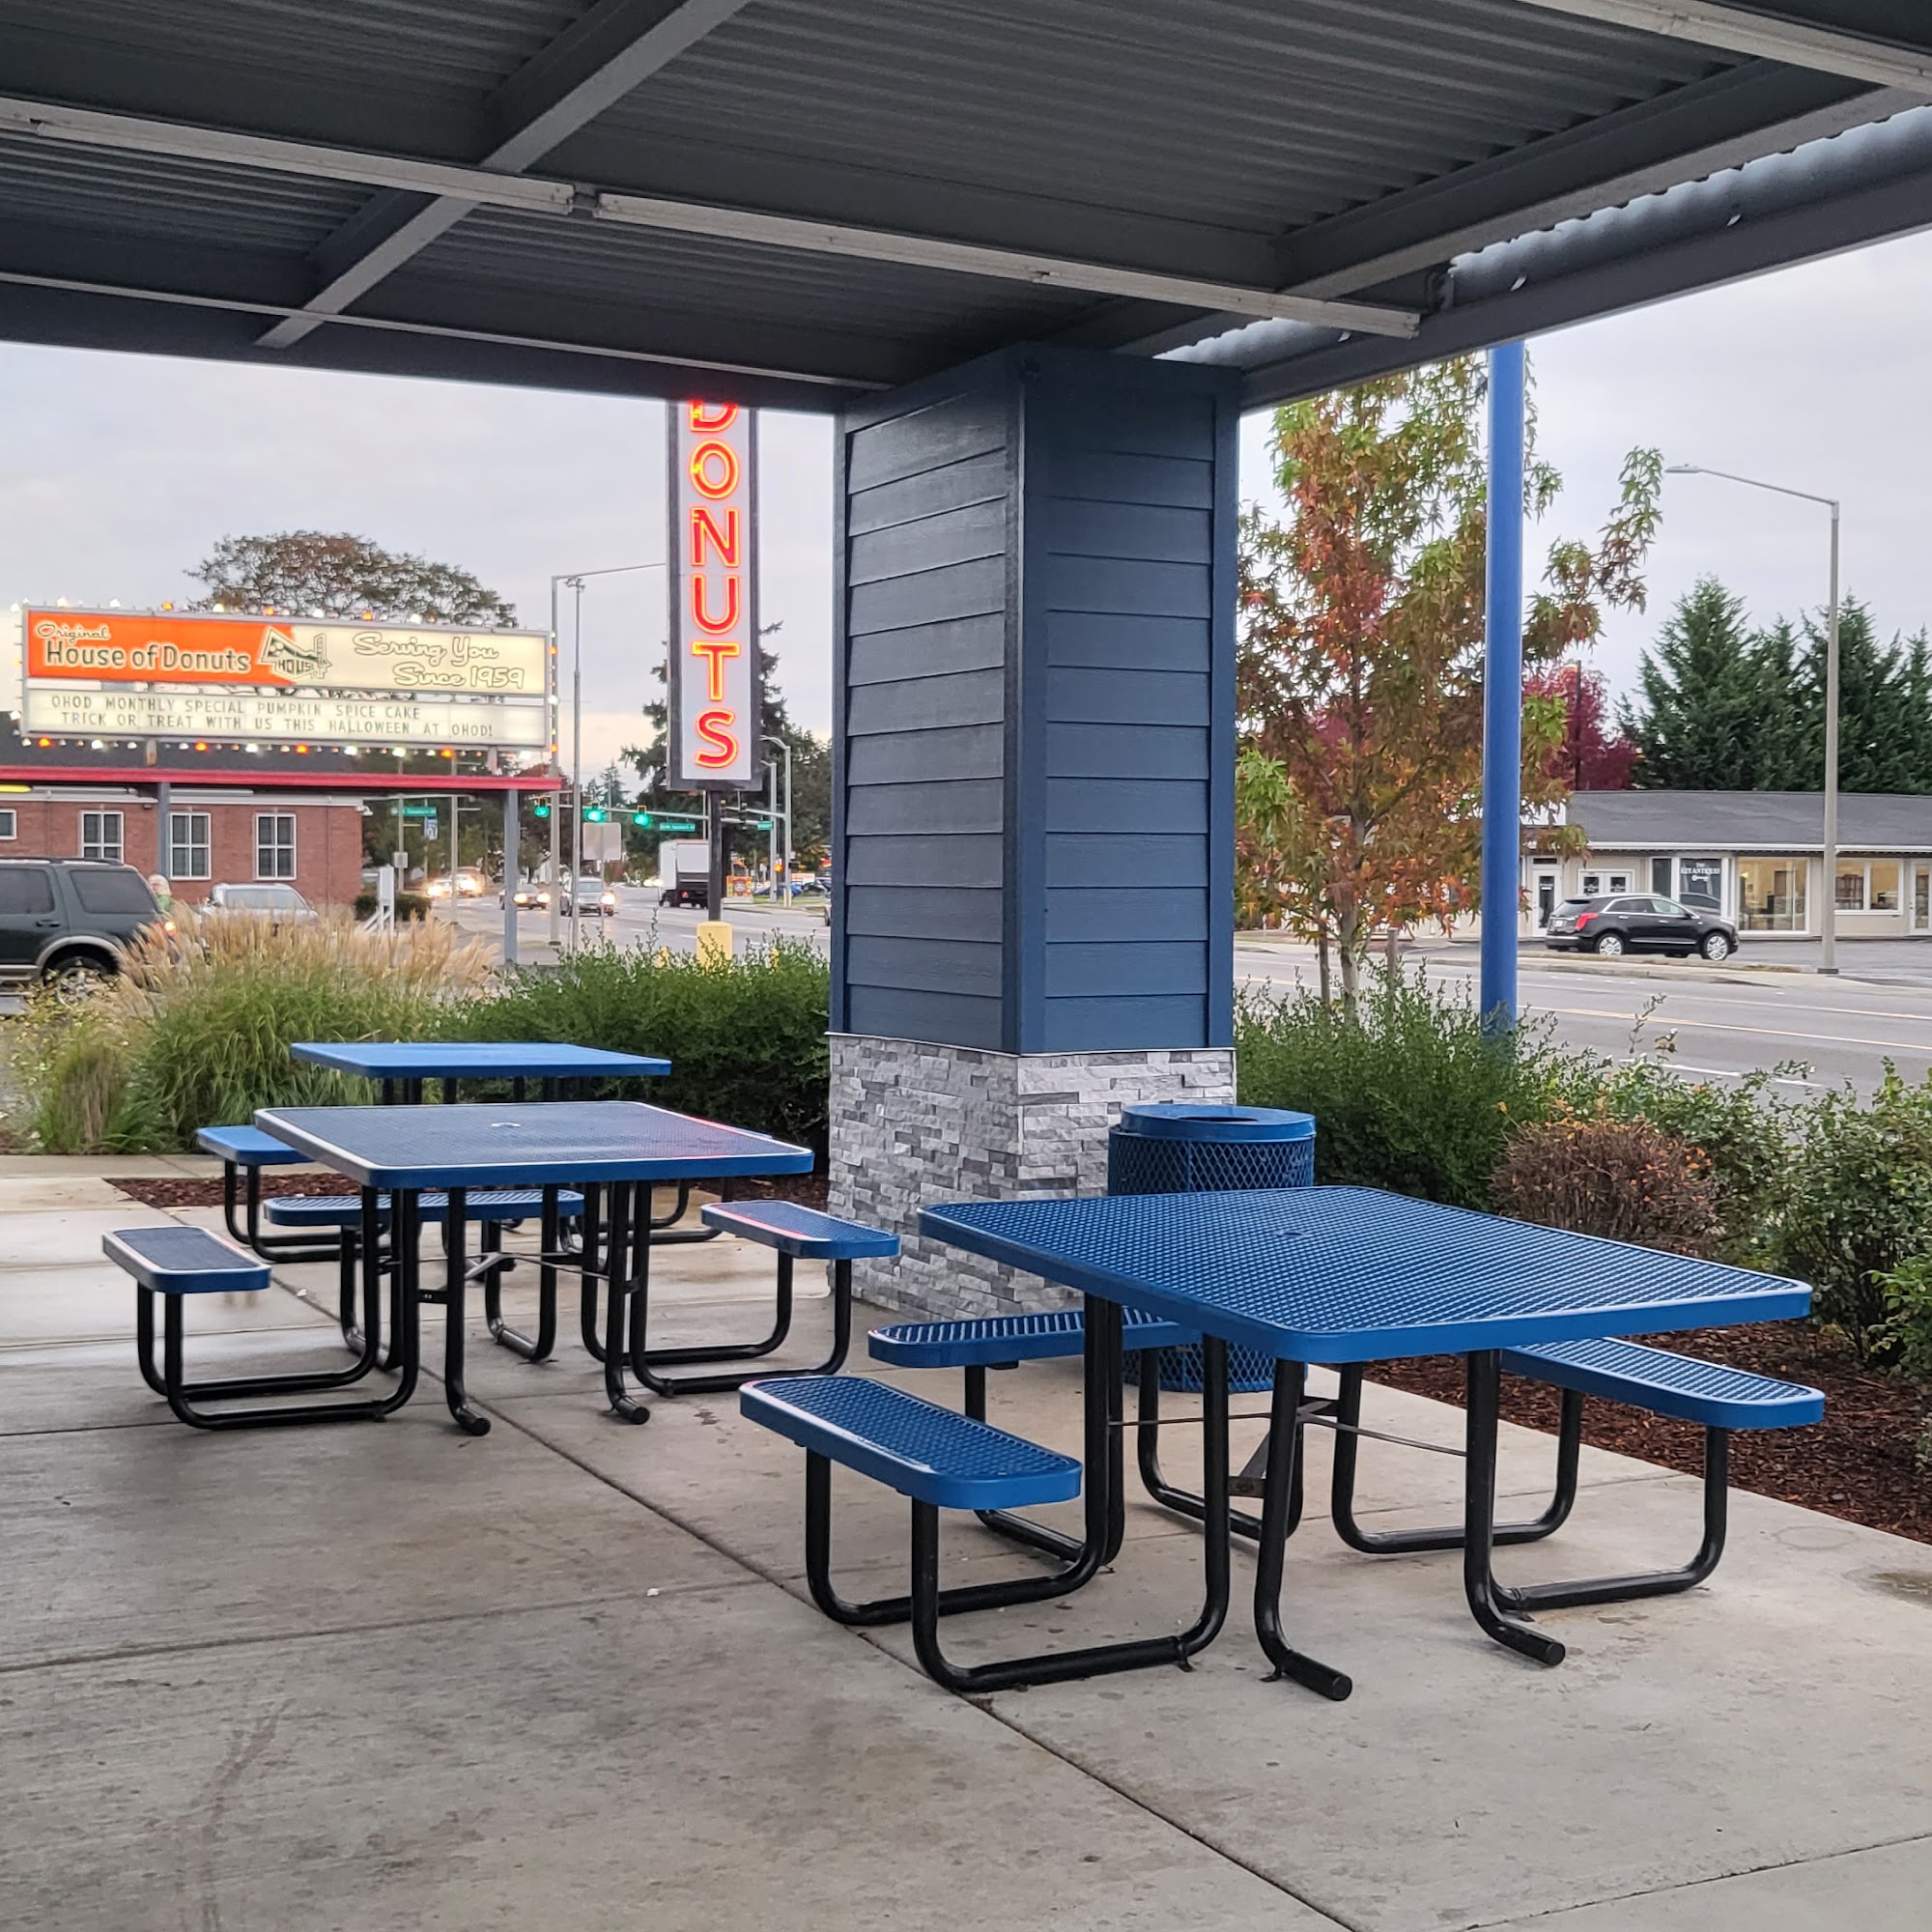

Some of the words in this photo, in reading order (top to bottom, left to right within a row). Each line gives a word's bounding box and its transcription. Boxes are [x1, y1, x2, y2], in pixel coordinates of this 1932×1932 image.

[689, 399, 740, 769] DONUTS
[37, 622, 111, 644] Original
[46, 639, 125, 667] House
[131, 643, 158, 669] of
[162, 644, 251, 672] Donuts
[353, 631, 447, 667] Serving
[450, 636, 499, 667] You
[392, 662, 466, 687] Since
[469, 665, 525, 689] 1959
[51, 695, 93, 709] OHOD
[105, 696, 176, 712] MONTHLY
[185, 698, 245, 714] SPECIAL
[257, 701, 322, 716] PUMPKIN
[335, 704, 376, 718] SPICE
[384, 705, 421, 720] CAKE
[62, 711, 106, 724] TRICK
[116, 713, 137, 726] OR
[147, 714, 194, 728] TREAT
[206, 715, 242, 729] WITH
[254, 718, 272, 730] US
[285, 719, 315, 731] THIS
[328, 720, 411, 734] HALLOWEEN
[423, 723, 440, 735] AT
[451, 724, 494, 737] OHOD!
